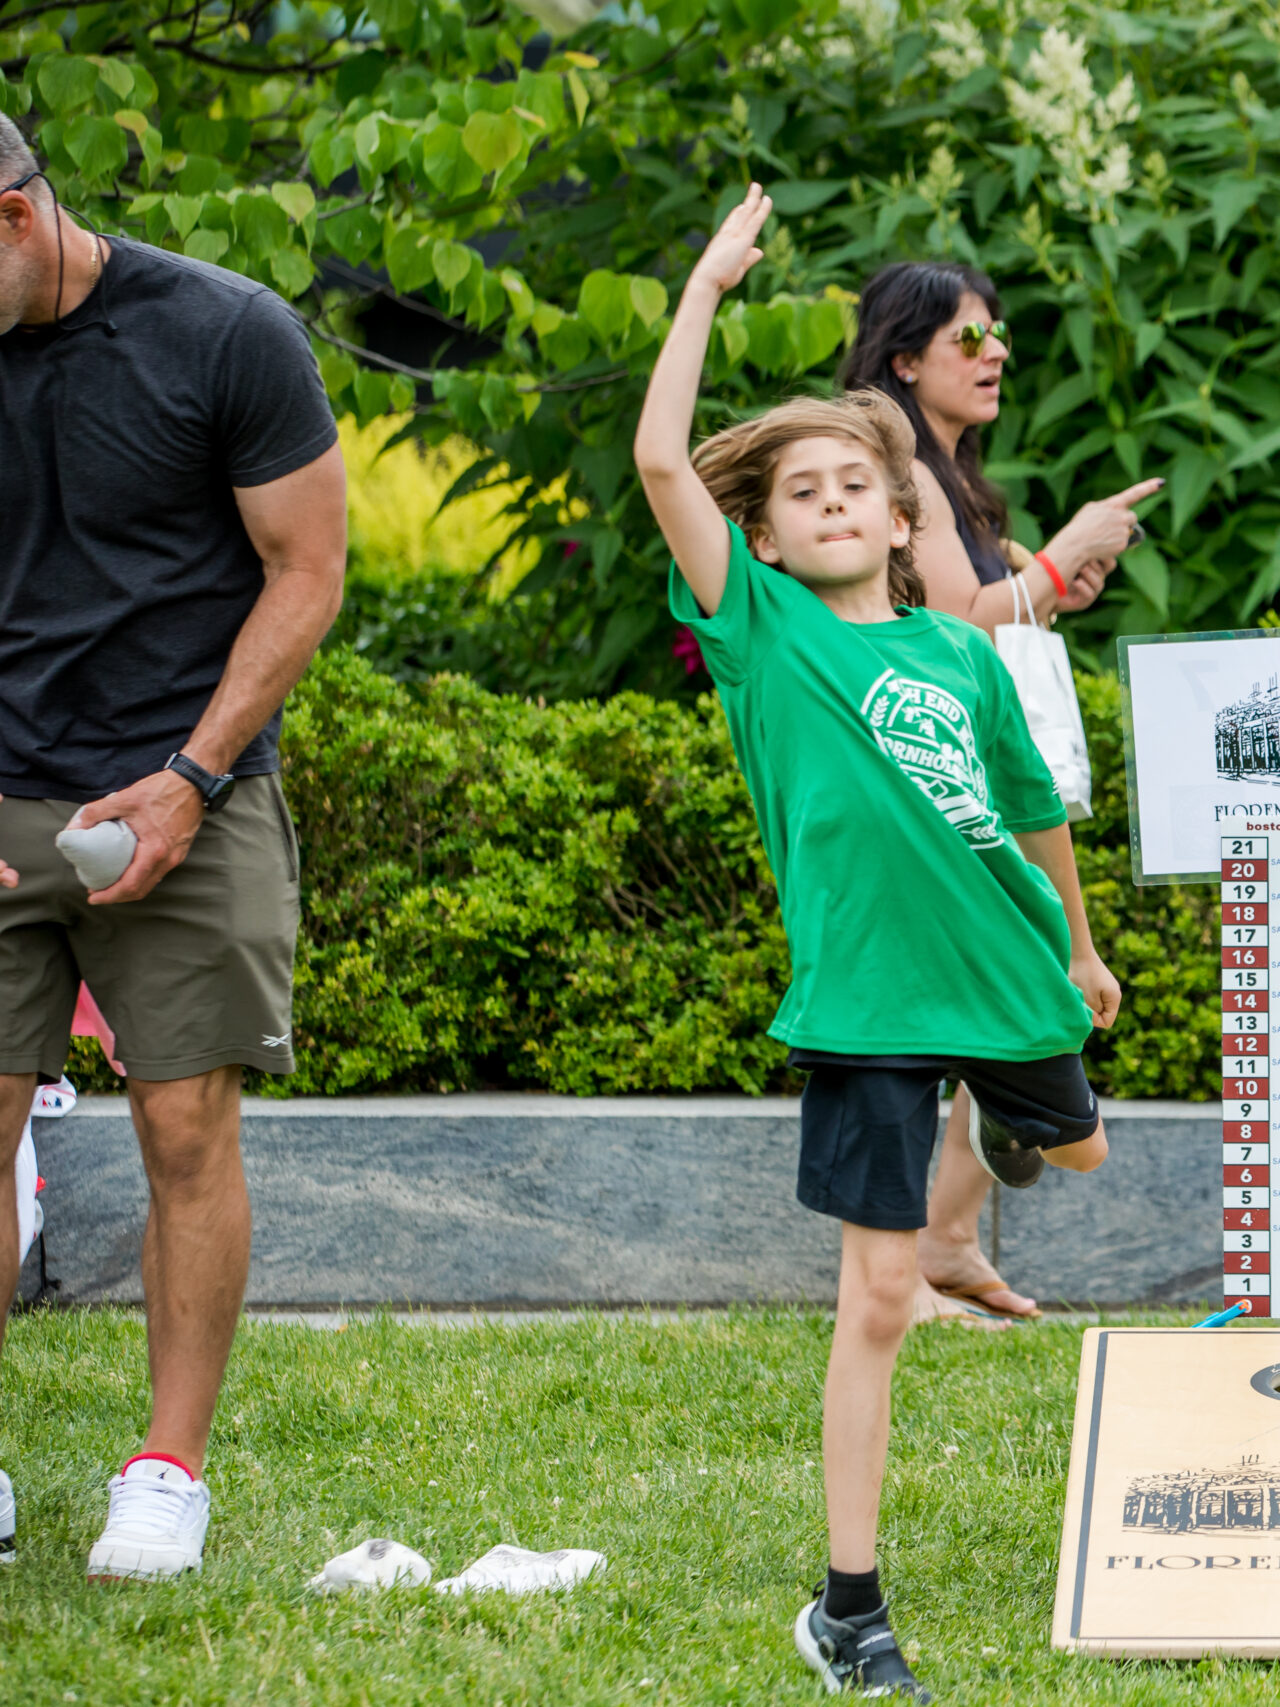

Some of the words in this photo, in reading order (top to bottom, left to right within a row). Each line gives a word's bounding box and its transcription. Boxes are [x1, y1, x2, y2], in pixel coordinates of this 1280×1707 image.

[924, 690, 961, 723] END
[1231, 840, 1253, 855] 21
[1231, 862, 1255, 878] 20
[1233, 884, 1256, 900] 19
[1232, 906, 1255, 921] 18
[1233, 928, 1256, 943] 17
[1232, 950, 1256, 965] 16
[1234, 972, 1257, 987] 15
[1233, 993, 1257, 1009] 14
[1235, 1015, 1257, 1031] 13
[1234, 1036, 1258, 1052] 12
[1235, 1059, 1256, 1074] 11
[1234, 1080, 1258, 1096] 10
[1240, 1103, 1252, 1118] 9
[1240, 1124, 1252, 1139] 8
[1240, 1146, 1252, 1161] 7
[1240, 1168, 1253, 1183] 6
[1241, 1190, 1252, 1205] 5
[1240, 1212, 1253, 1227] 4
[1241, 1233, 1252, 1249] 3
[1240, 1255, 1252, 1270] 2
[1242, 1277, 1251, 1292] 1
